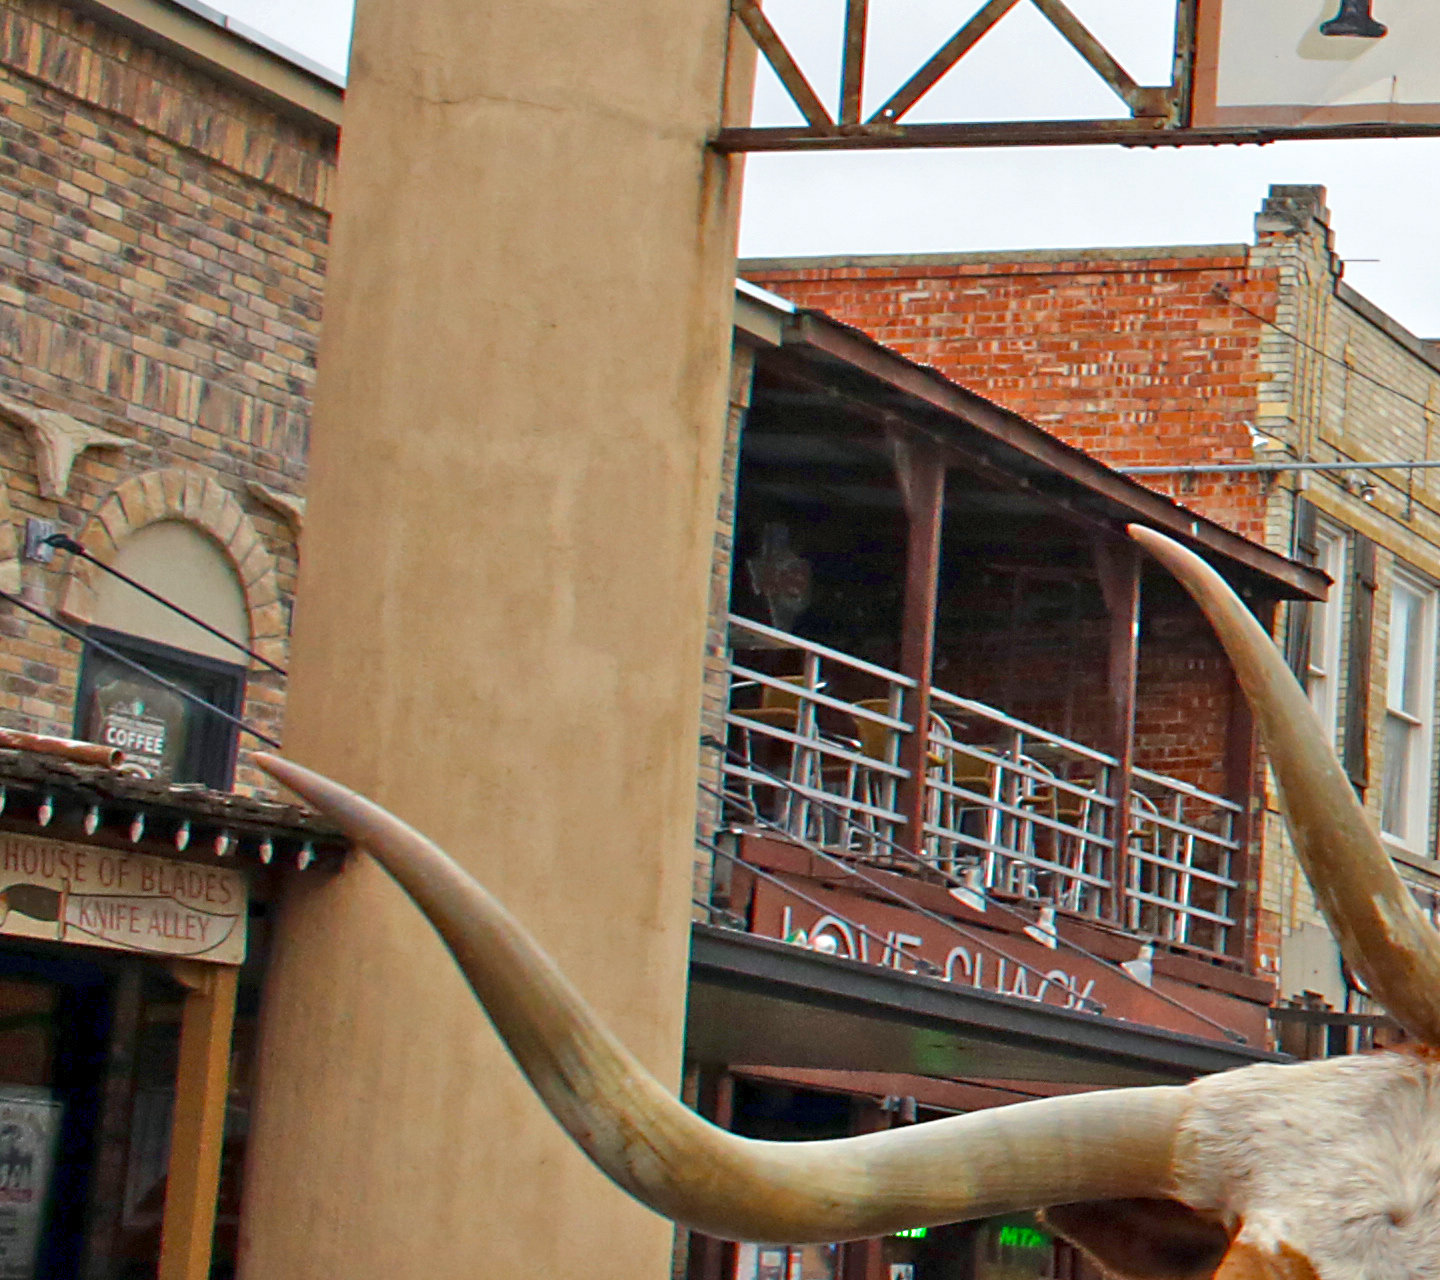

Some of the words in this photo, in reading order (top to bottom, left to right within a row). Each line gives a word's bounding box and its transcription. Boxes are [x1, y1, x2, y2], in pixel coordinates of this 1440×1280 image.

[106, 726, 164, 755] COFFEE
[3, 841, 87, 883] HOUSE
[99, 856, 129, 888] OF
[142, 864, 232, 905] BLADES
[79, 898, 141, 934] KNIFE
[150, 909, 212, 942] ALLEY
